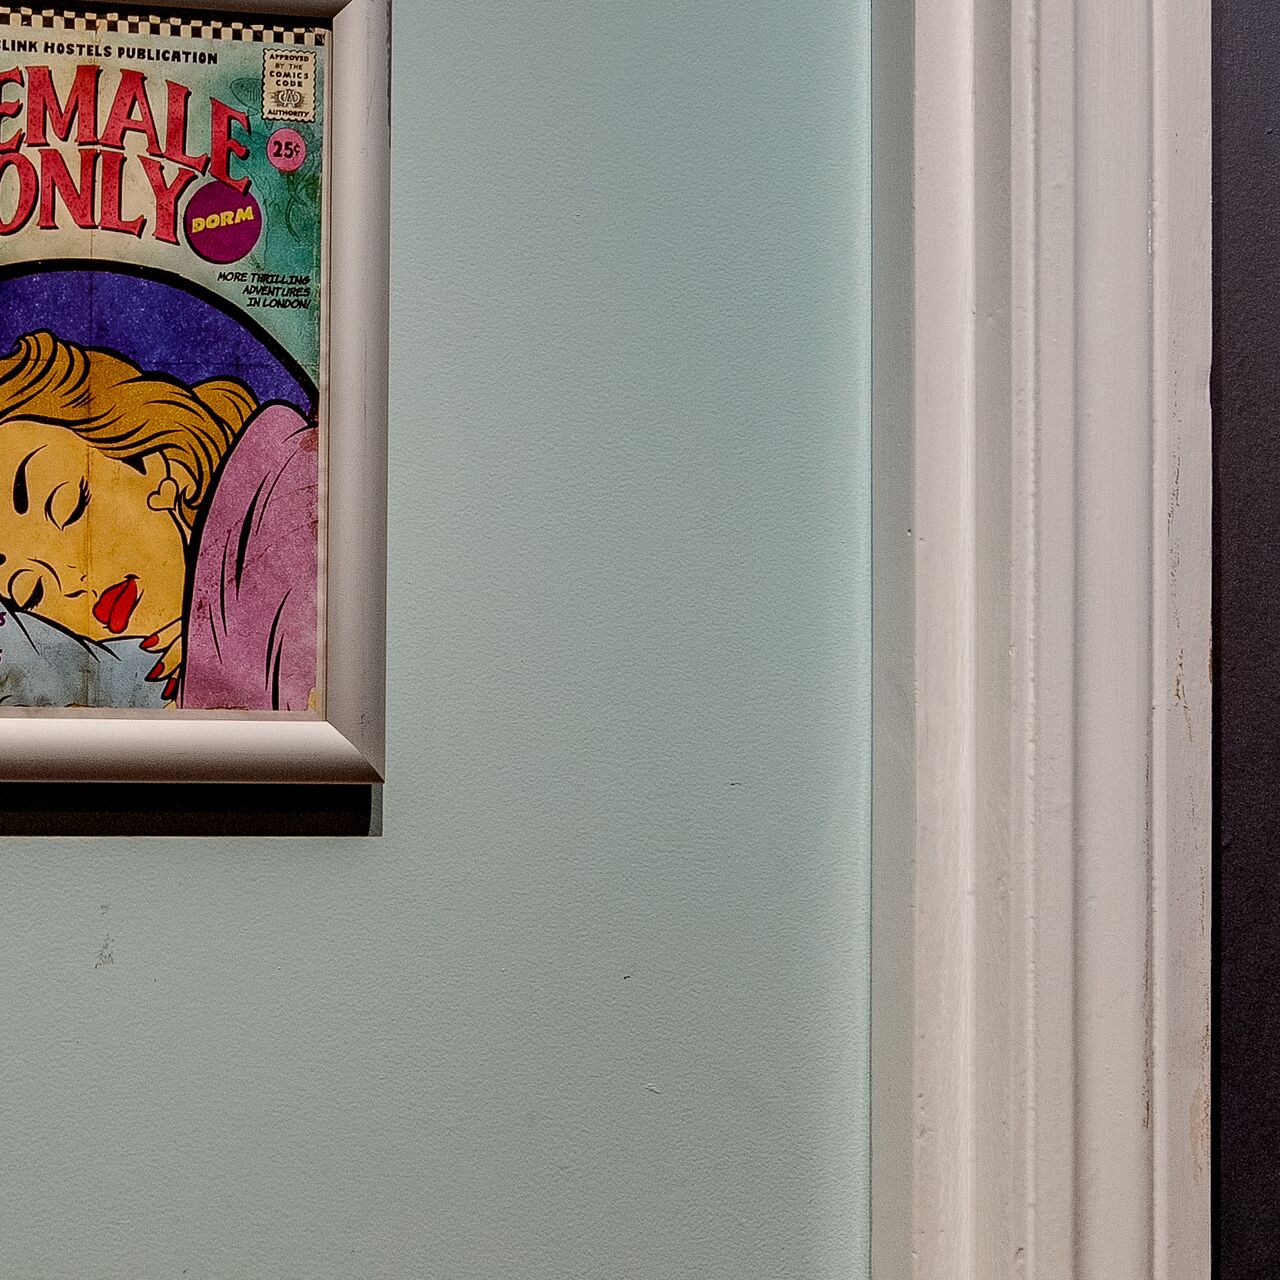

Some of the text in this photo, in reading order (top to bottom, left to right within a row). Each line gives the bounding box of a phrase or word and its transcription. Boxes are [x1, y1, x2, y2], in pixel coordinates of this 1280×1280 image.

[44, 42, 112, 57] HOSTELS
[118, 46, 218, 64] PUBLICATION
[269, 54, 309, 62] APPROVED
[269, 71, 308, 79] COMICS
[268, 109, 310, 117] AUTHORITY
[192, 206, 254, 233] DORM
[217, 272, 311, 285] MORE THRILLING
[242, 285, 311, 297] ADVENTURES
[246, 297, 311, 309] IN LONDON!
